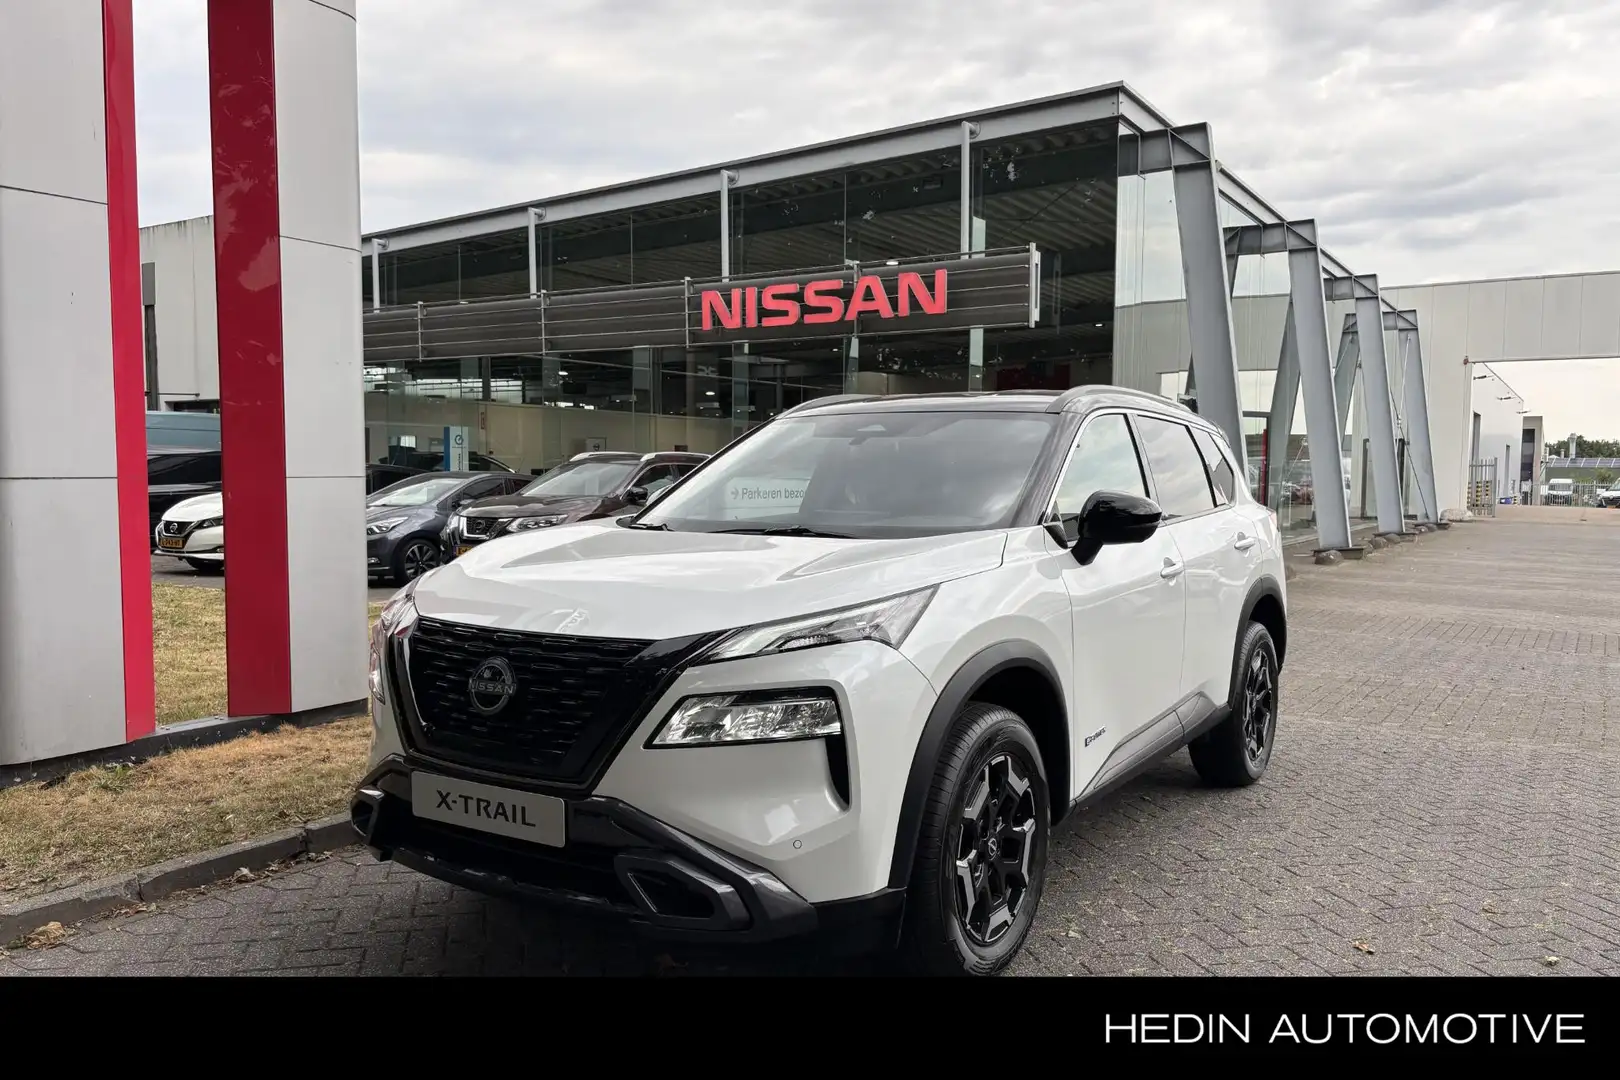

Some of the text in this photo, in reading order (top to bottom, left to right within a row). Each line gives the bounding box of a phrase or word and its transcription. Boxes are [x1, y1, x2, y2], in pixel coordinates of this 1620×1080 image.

[701, 268, 947, 331] NISSAN
[741, 487, 782, 499] Parkeren
[468, 678, 515, 694] NISSAN
[436, 789, 536, 828] X-TRAIL
